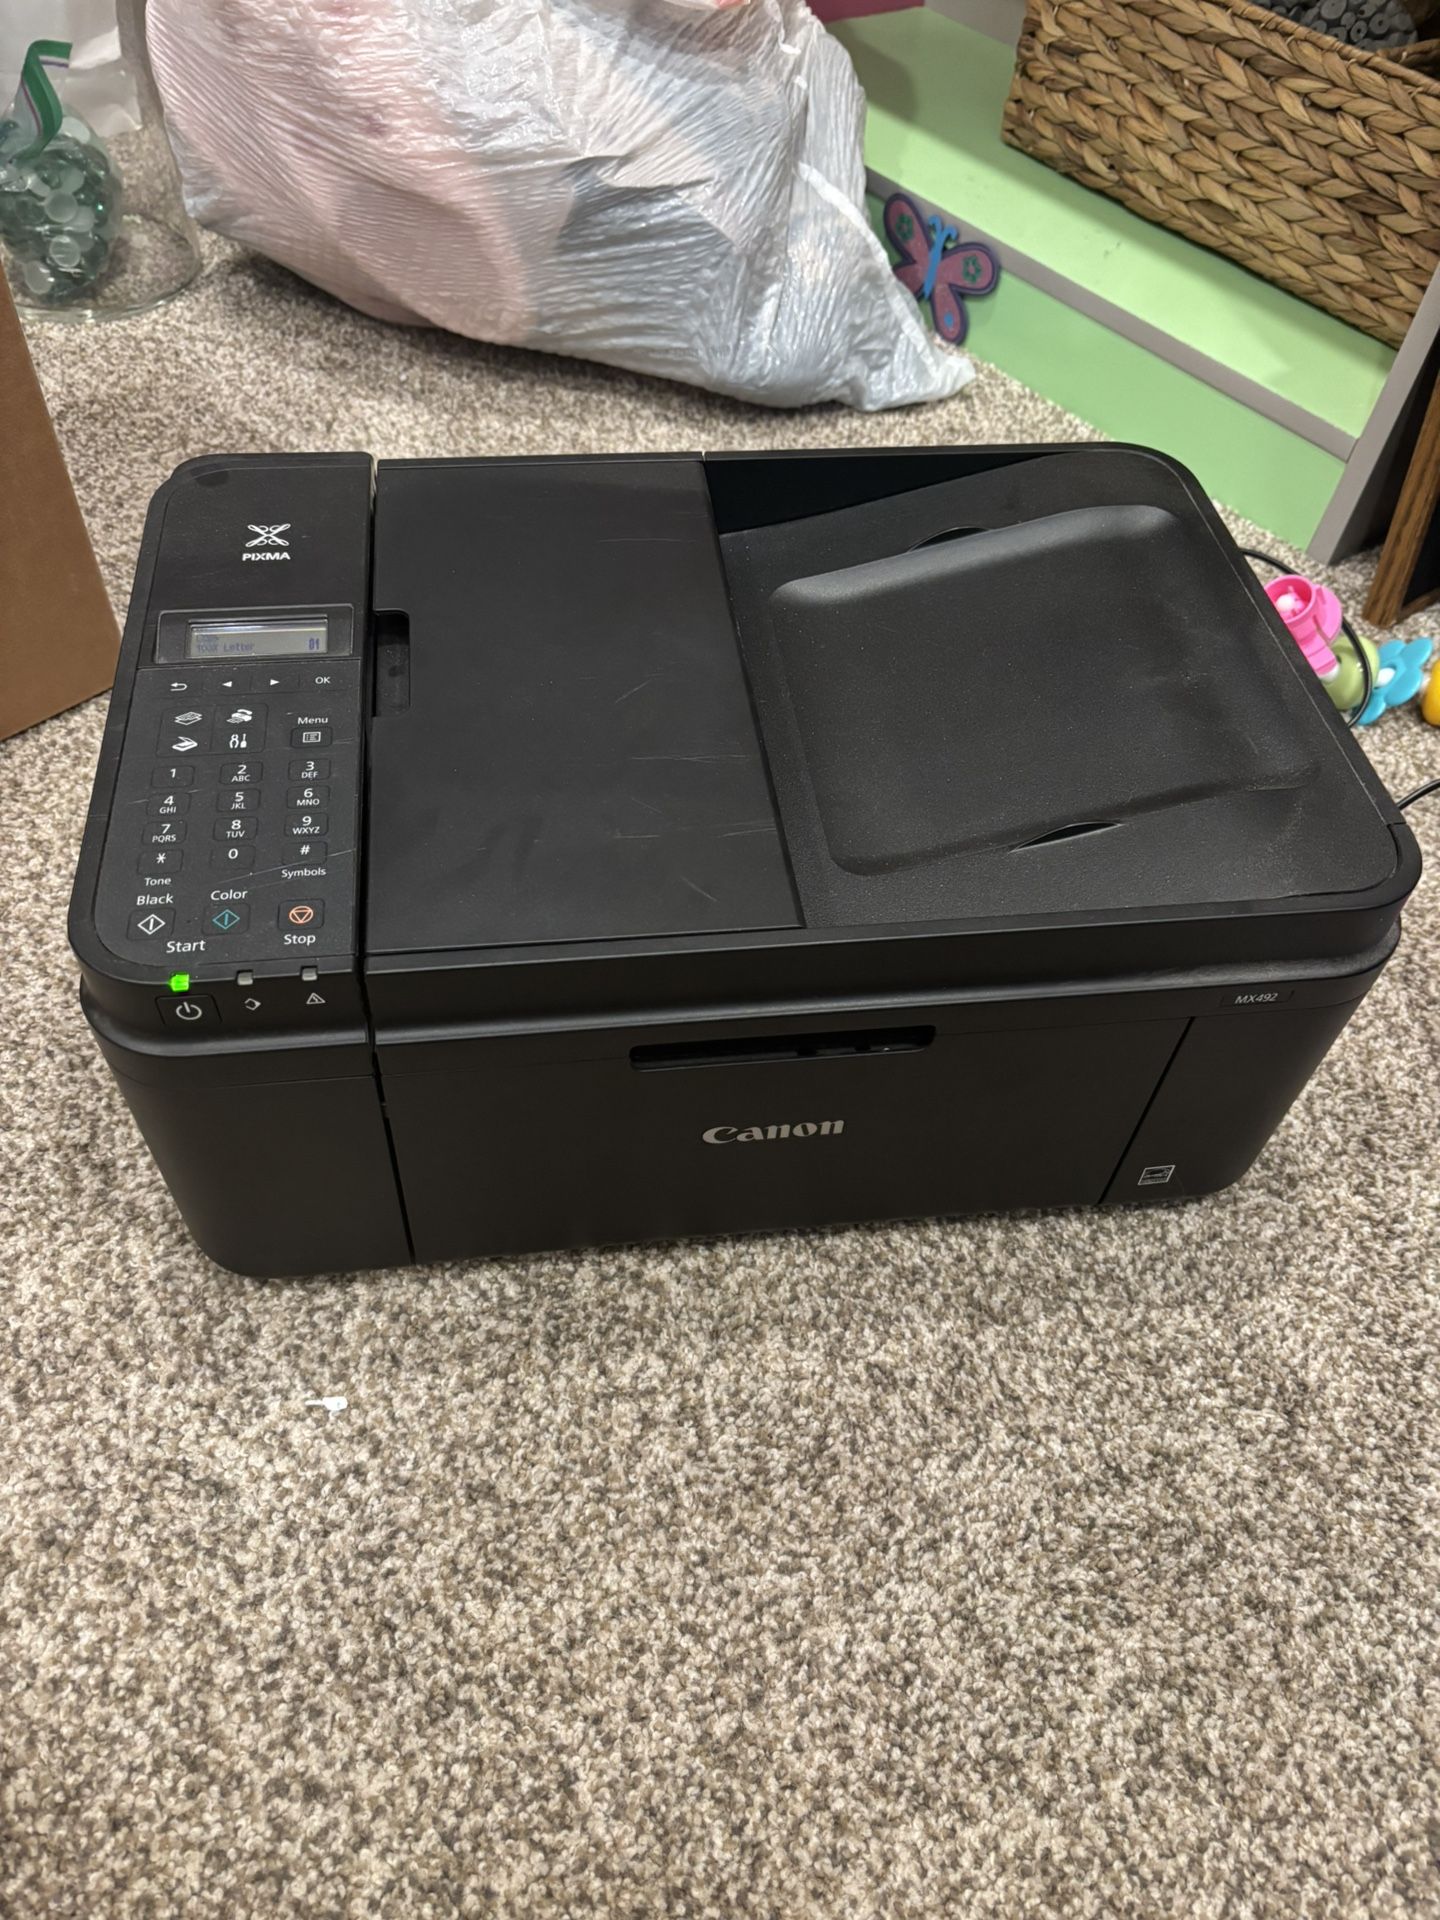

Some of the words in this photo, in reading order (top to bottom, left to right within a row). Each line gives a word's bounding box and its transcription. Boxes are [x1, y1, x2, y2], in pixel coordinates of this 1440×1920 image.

[242, 552, 291, 561] PIXMA
[315, 676, 331, 684] OK
[297, 717, 329, 725] Menu
[237, 764, 247, 775] 2
[305, 761, 315, 771] 3
[170, 768, 177, 778] 1
[231, 774, 251, 782] ABC
[301, 771, 318, 779] DEF
[234, 791, 244, 802] 5
[303, 788, 313, 798] 6
[163, 795, 174, 806] 4
[296, 798, 320, 806] MNO
[159, 806, 177, 814] GHI
[230, 802, 246, 810] JKL
[231, 819, 241, 830] 8
[302, 816, 312, 826] 9
[161, 823, 171, 834] 7
[292, 826, 320, 835] WXYZ
[151, 834, 177, 844] PQRS
[226, 830, 245, 838] TUV
[281, 868, 327, 879] Symbols
[144, 877, 172, 886] Tone
[136, 893, 174, 906] Black
[210, 889, 248, 901] Color
[283, 934, 316, 946] Stop
[166, 939, 206, 953] Start
[1234, 993, 1279, 1004] MX492
[702, 1120, 845, 1144] Canon
